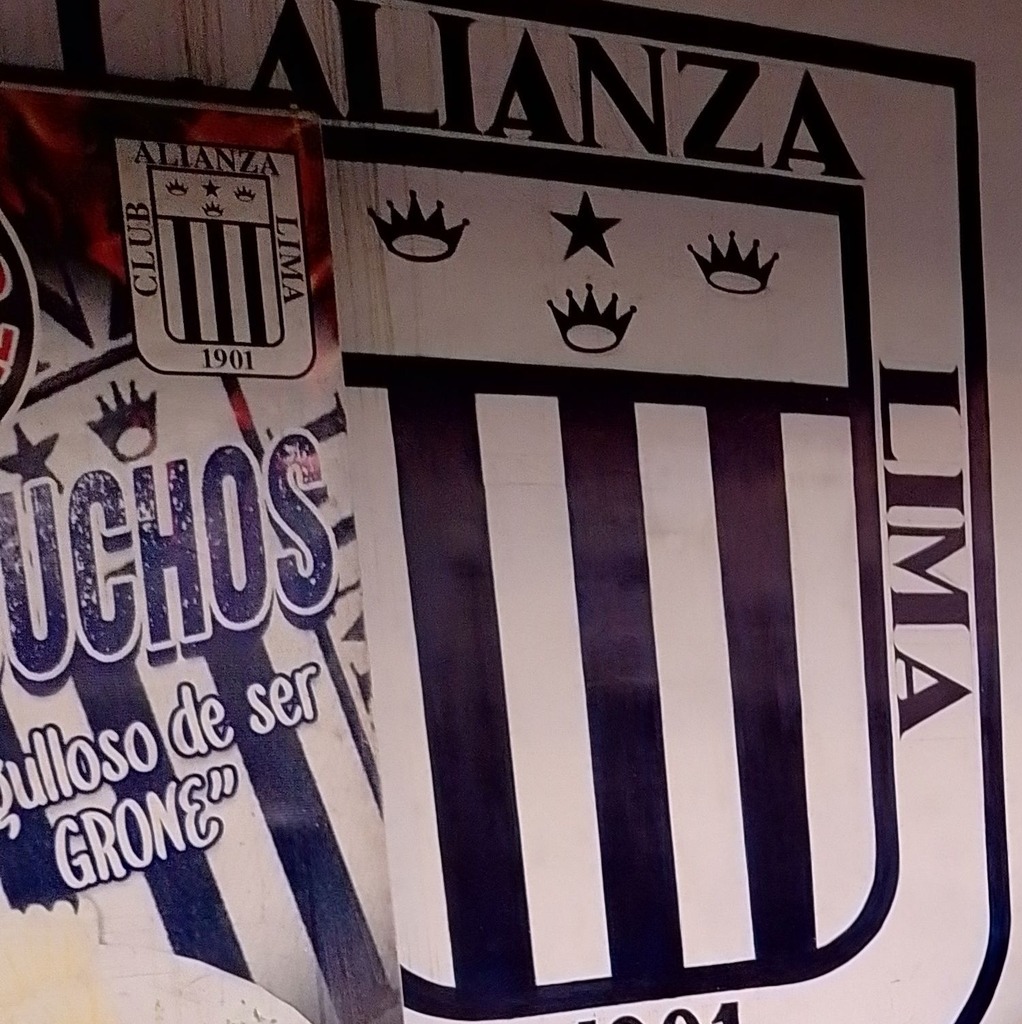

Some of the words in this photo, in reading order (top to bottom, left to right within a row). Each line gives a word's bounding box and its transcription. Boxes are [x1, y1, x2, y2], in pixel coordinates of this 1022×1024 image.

[252, 0, 866, 181] ALIANZA
[133, 141, 280, 176] ALIANZA
[125, 202, 159, 297] CLUB
[275, 215, 304, 304] LIMA
[202, 348, 255, 371] 1901
[879, 357, 972, 740] LIMA
[171, 682, 235, 757] de
[247, 664, 320, 734] ser
